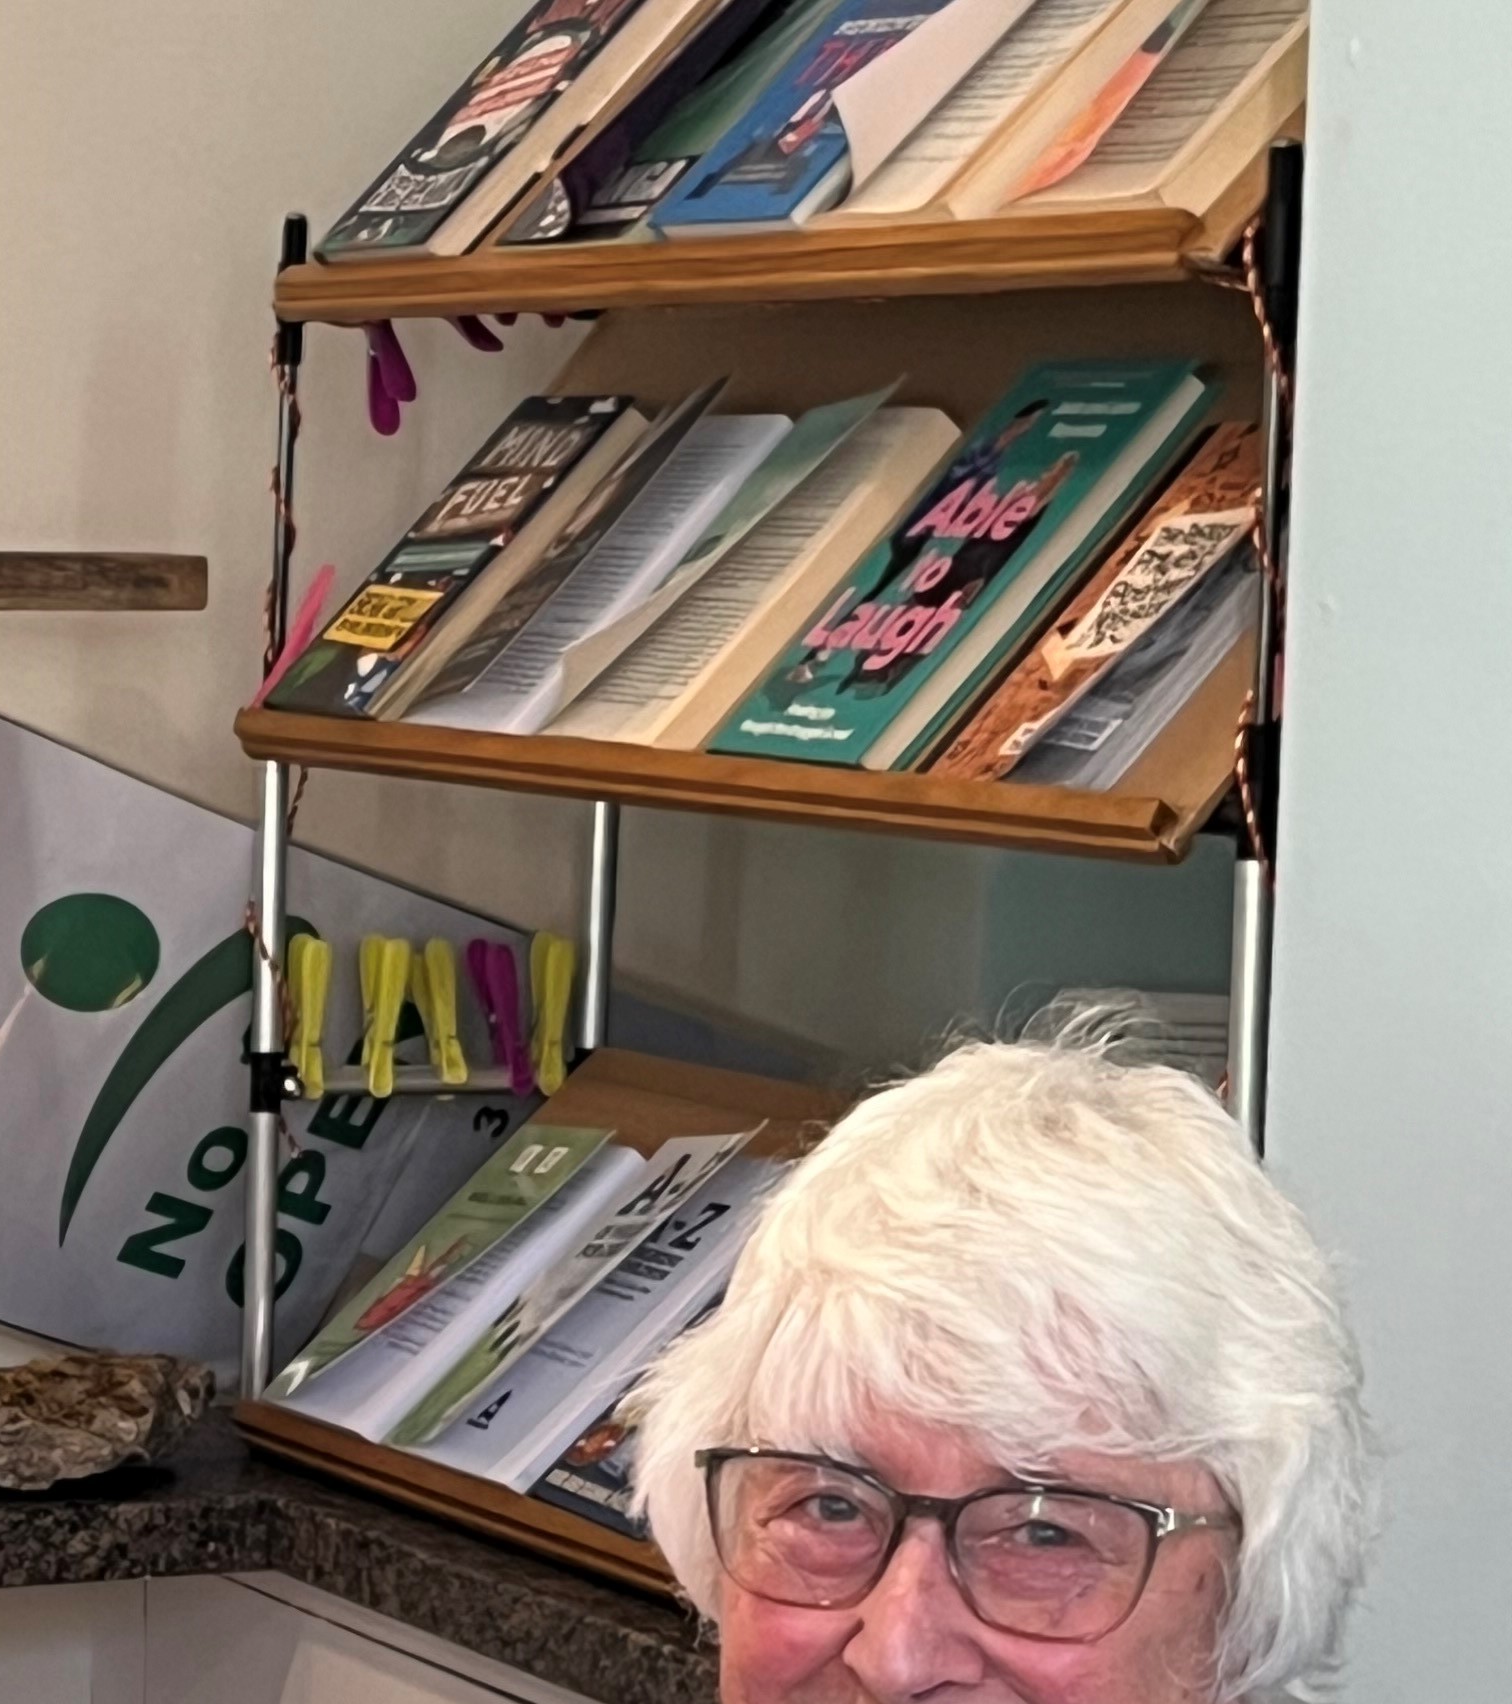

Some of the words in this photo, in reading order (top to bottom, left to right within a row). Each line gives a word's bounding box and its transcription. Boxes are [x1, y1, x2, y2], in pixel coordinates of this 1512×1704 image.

[436, 473, 533, 524] FUEL
[905, 478, 1038, 540] Able
[801, 587, 963, 671] Laugh
